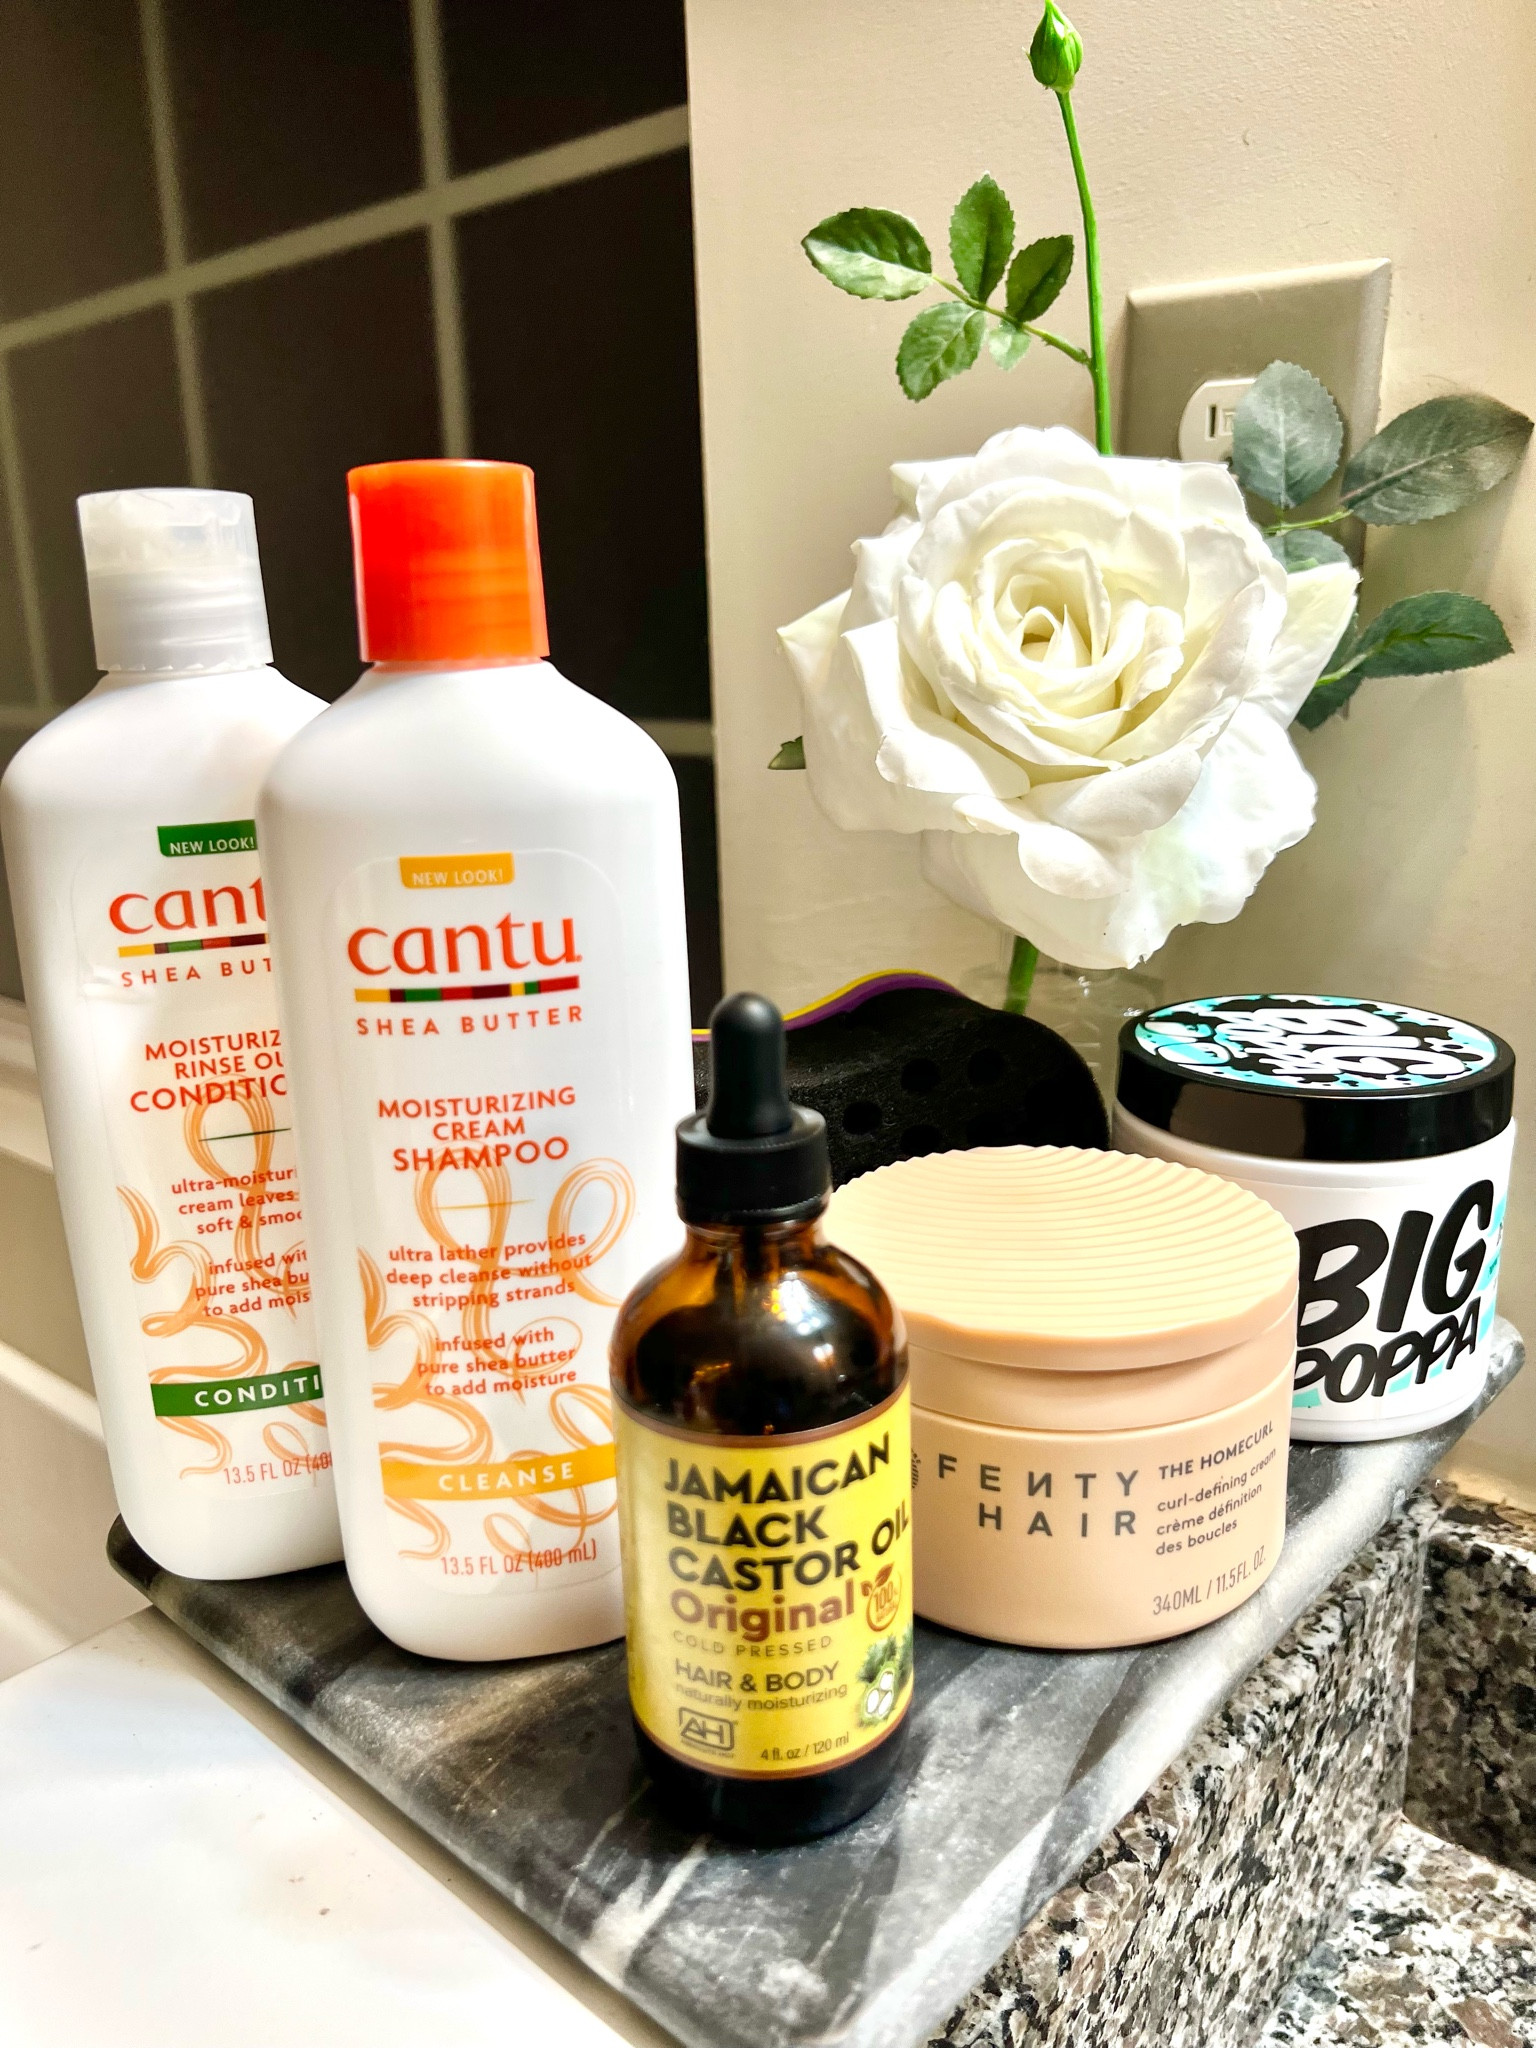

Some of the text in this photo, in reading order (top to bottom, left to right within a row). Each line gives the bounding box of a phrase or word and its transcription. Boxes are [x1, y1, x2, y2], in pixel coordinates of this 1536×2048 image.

[170, 837, 256, 854] NEW LOOK!
[412, 868, 503, 886] NEW LOOK!
[347, 912, 580, 976] cantu
[121, 965, 201, 987] SHEA
[357, 1006, 583, 1035] SHEA BUTTER
[145, 1029, 281, 1060] MOISTURIZ
[175, 1054, 246, 1080] RINSE
[378, 1086, 576, 1118] MOISTURIZING
[433, 1117, 525, 1141] CREAM
[393, 1136, 569, 1172] SHAMPOO
[178, 1190, 295, 1215] cream leaves
[197, 1216, 234, 1235] soft
[240, 1215, 253, 1229] &
[389, 1233, 586, 1262] ultra lather provides
[209, 1253, 275, 1276] infused
[387, 1254, 592, 1288] deep cleanse without
[1295, 1179, 1494, 1348] BIG
[195, 1283, 235, 1301] pure
[242, 1275, 282, 1293] shea
[413, 1280, 576, 1310] stripping strands
[203, 1291, 310, 1318] to add mois
[435, 1326, 555, 1352] infused with
[1293, 1296, 1481, 1403] POPPA
[418, 1347, 576, 1376] pure shea butter
[425, 1369, 577, 1396] to add moisture
[1159, 1420, 1273, 1480] THE HOMECURL
[224, 1465, 255, 1484] 13.5
[260, 1463, 278, 1480] FL
[283, 1457, 301, 1477] OZ
[439, 1462, 574, 1491] CLEANSE
[664, 1431, 889, 1504] JAMAICAN
[1157, 1448, 1276, 1512] curl-defining cream
[668, 1500, 828, 1548] BLACK
[979, 1503, 1136, 1538] HAIR
[1156, 1482, 1262, 1536] crème définition
[668, 1500, 908, 1591] CASTOR OIL
[1155, 1518, 1237, 1556] des boucles
[441, 1538, 597, 1575] 13.5 FL OZ (400 mL)
[671, 1578, 854, 1642] Original
[1153, 1584, 1202, 1616] 340ML
[673, 1630, 832, 1657] COLD PRESSED
[675, 1658, 839, 1692] HAIR & BODY
[676, 1683, 848, 1711] naturally moisturizing
[761, 1749, 769, 1760] 4
[772, 1747, 782, 1761] fl.
[787, 1749, 800, 1760] oz
[813, 1738, 832, 1755] 120
[835, 1731, 849, 1747] ml
